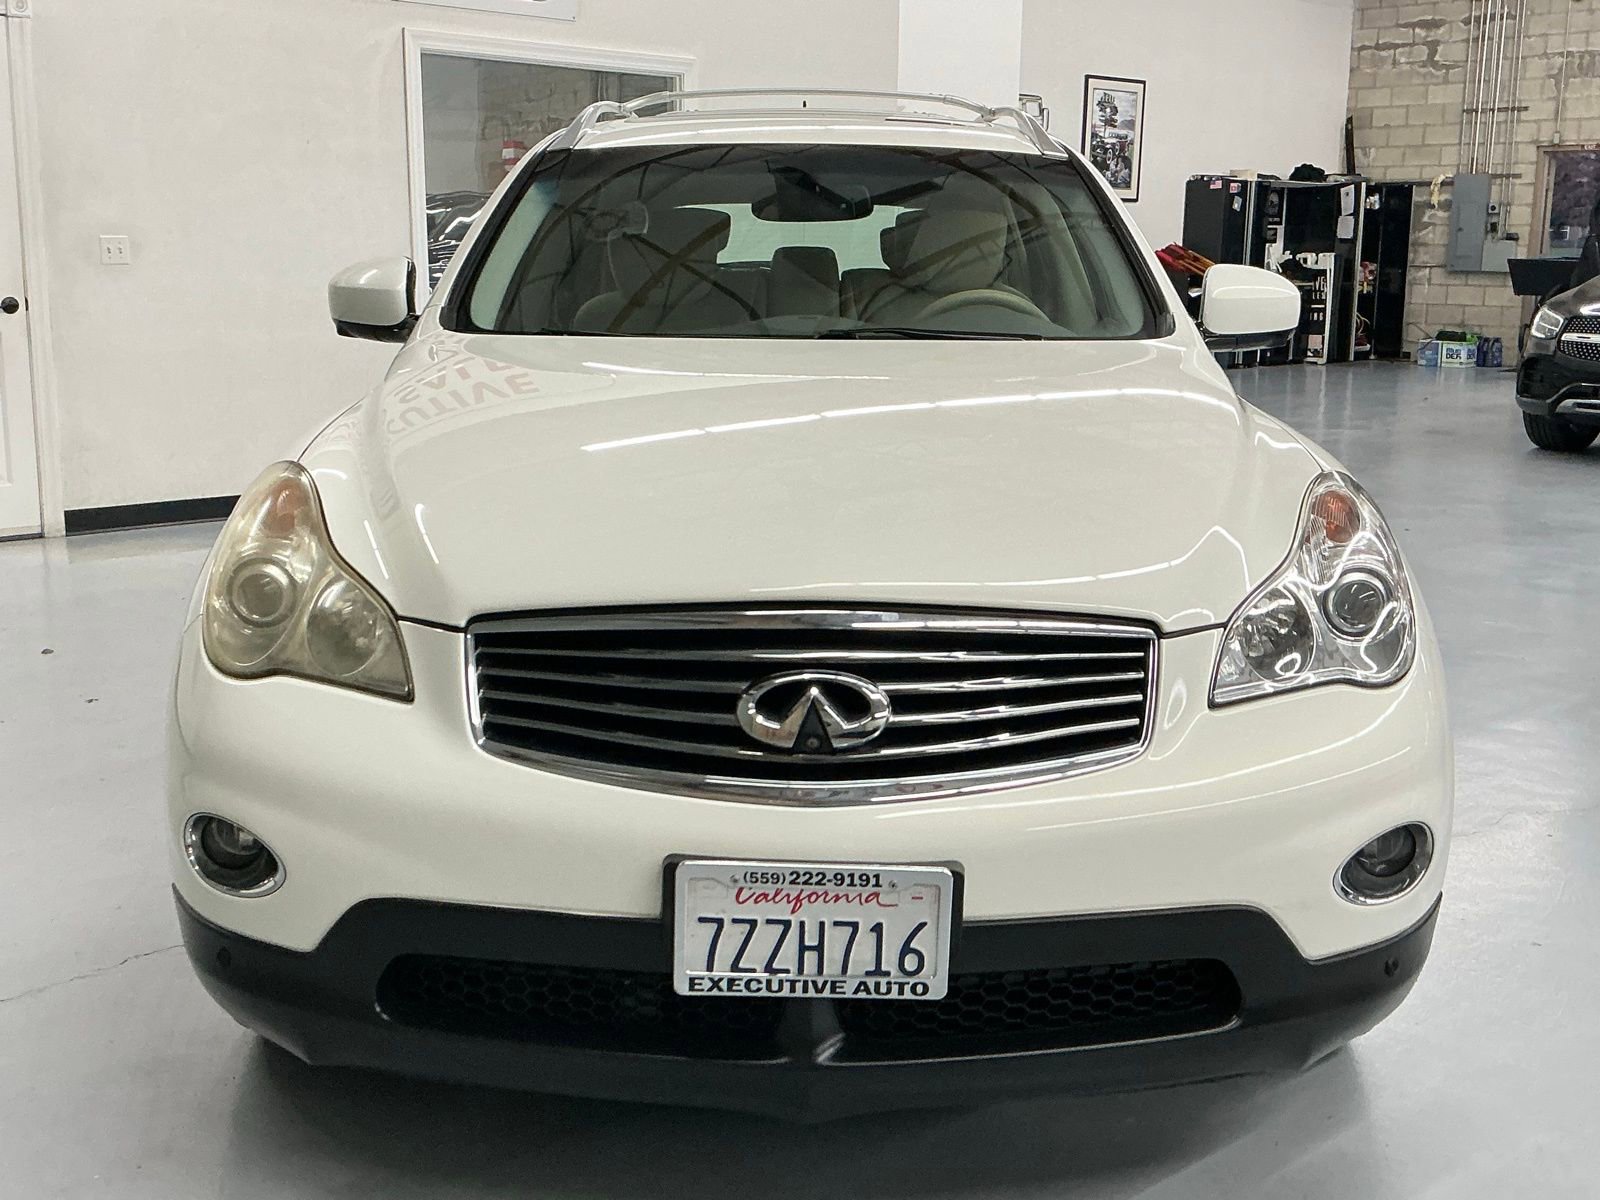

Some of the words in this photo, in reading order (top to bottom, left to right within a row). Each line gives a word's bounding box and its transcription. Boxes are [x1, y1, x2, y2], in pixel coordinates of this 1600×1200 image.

[743, 871, 787, 885] (559)
[788, 871, 883, 888] 222-9191
[735, 887, 898, 914] California
[697, 916, 928, 977] 7ZZH716
[688, 977, 847, 995] EXECUTIVE
[852, 980, 930, 997] AUTO
